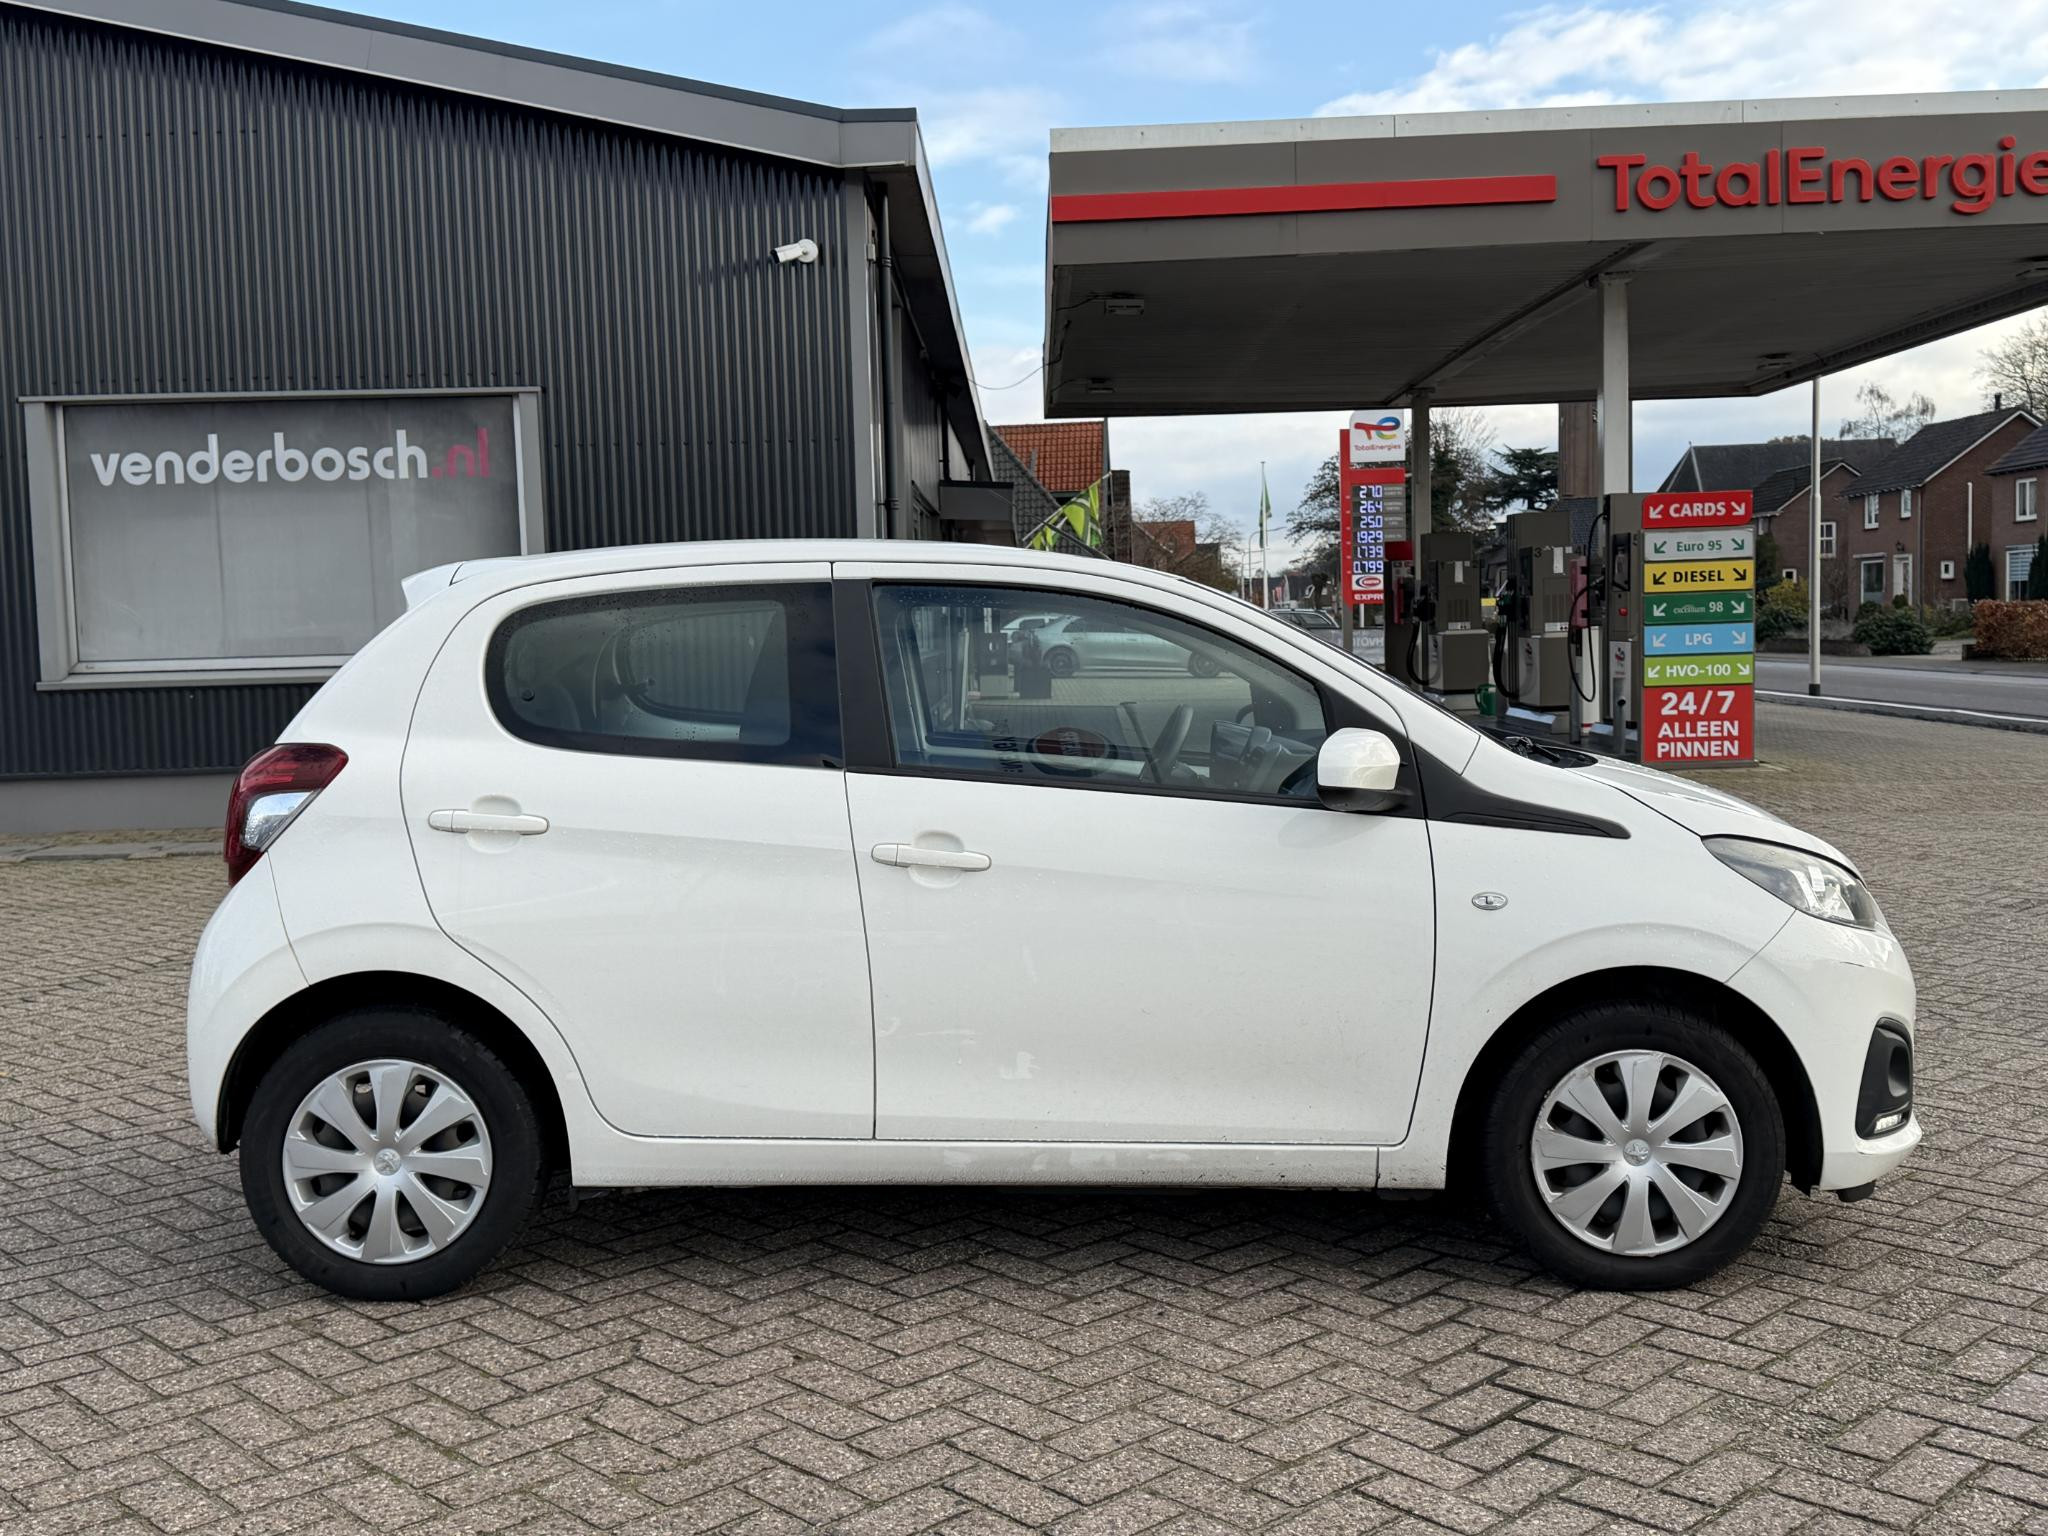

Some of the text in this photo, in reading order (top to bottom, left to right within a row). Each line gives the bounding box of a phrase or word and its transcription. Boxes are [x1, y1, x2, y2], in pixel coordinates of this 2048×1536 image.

[90, 428, 490, 487] venderbosch.nl
[1669, 502, 1726, 518] CARDS
[1676, 540, 1722, 552] Euro 95
[1673, 570, 1725, 583] DIESEL
[1709, 601, 1724, 613] 98
[1685, 632, 1712, 646] LPG
[1666, 663, 1731, 677] HVO-100
[1660, 690, 1736, 715] 24/7
[1658, 720, 1739, 738] ALLEEN
[1657, 740, 1739, 758] PINNEN
